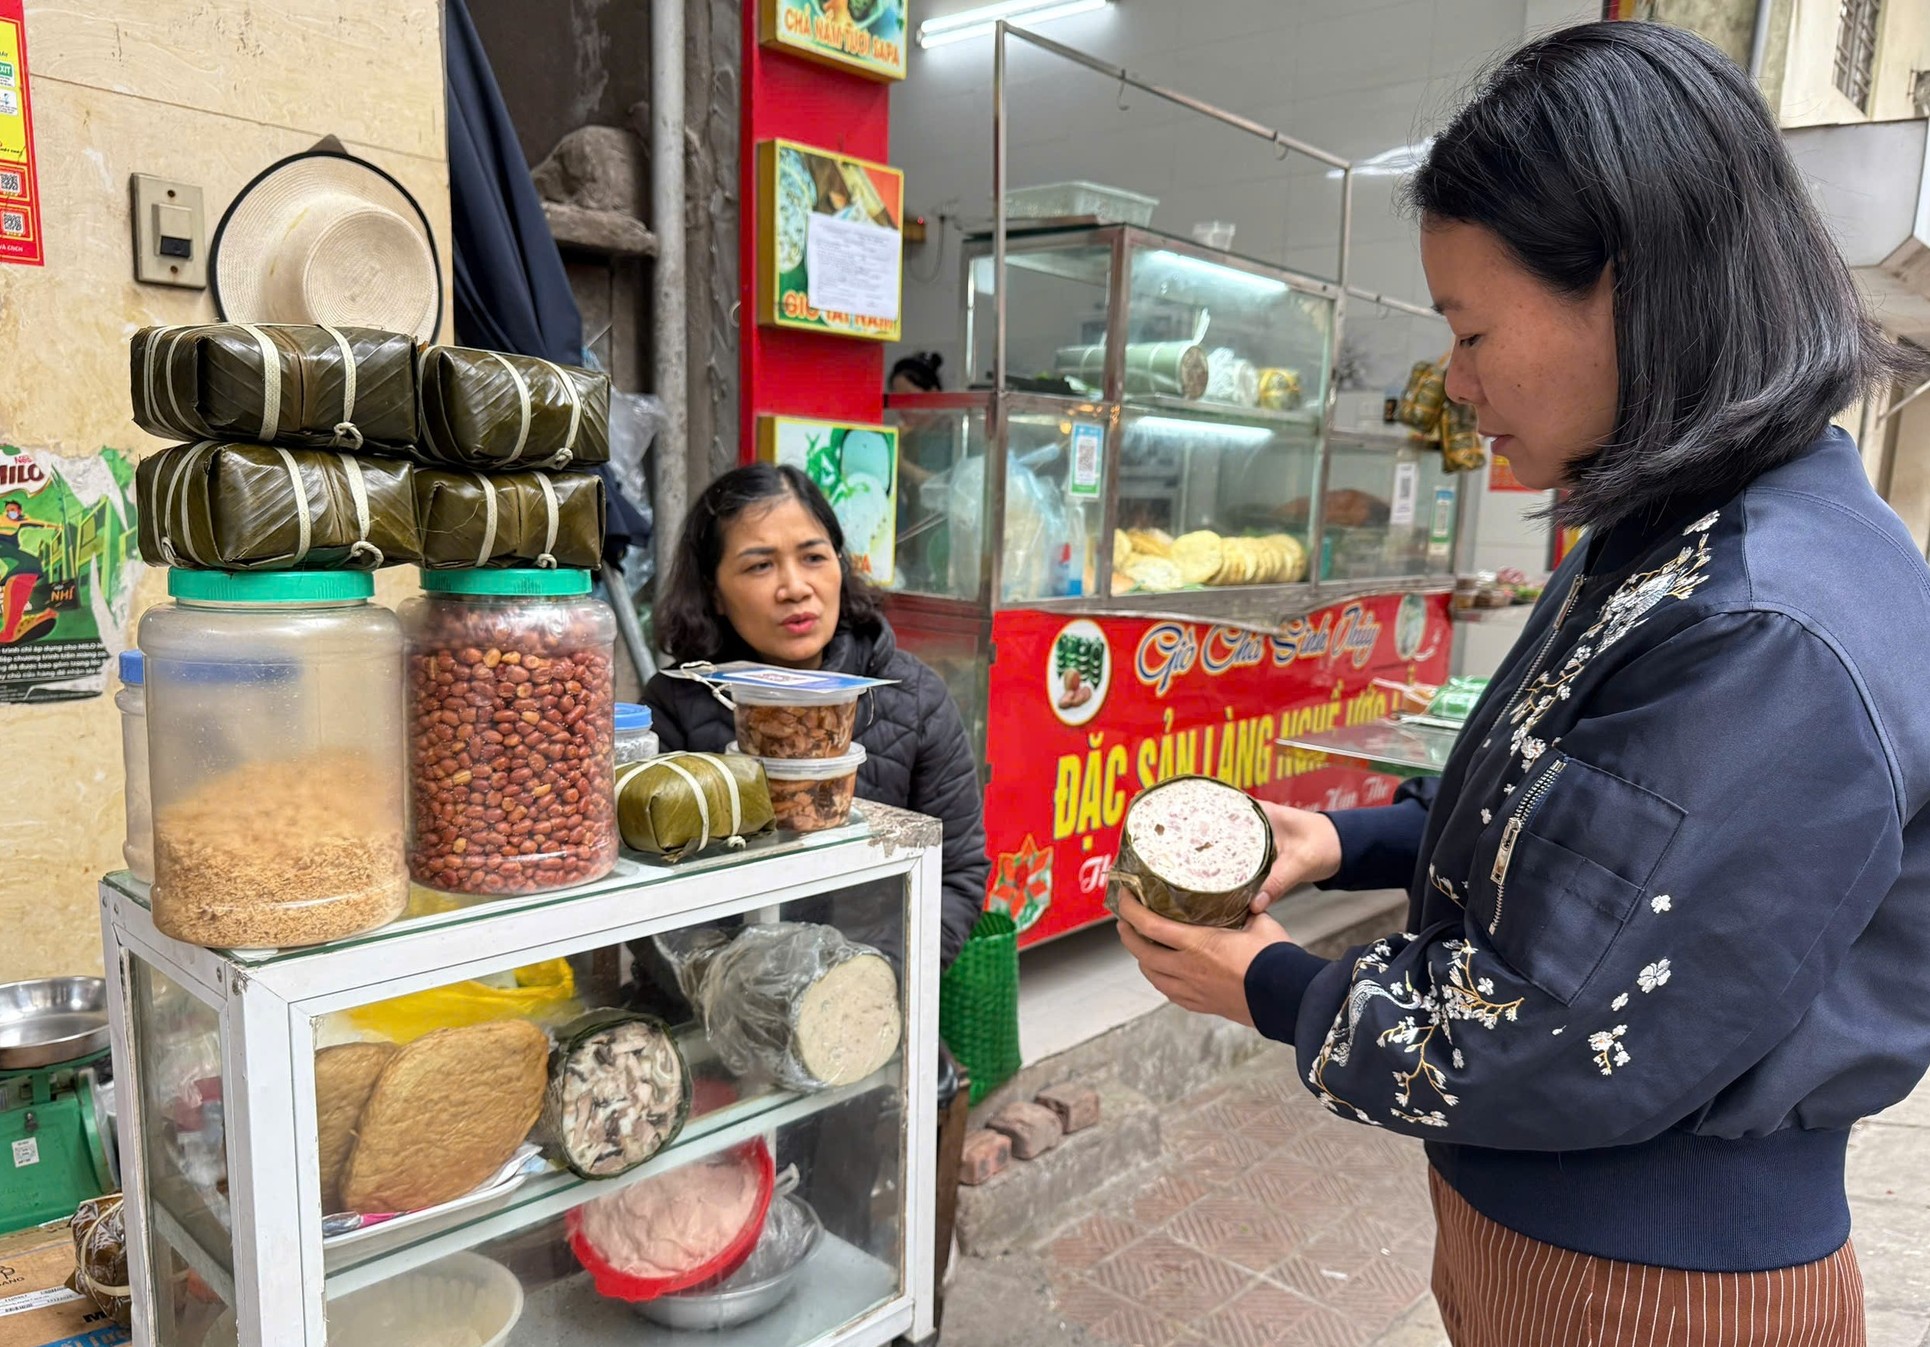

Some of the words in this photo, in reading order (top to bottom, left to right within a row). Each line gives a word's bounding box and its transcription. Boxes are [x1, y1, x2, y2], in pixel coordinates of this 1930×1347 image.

[872, 36, 900, 66] SAPA
[1134, 621, 1197, 696] Giò
[1054, 731, 1128, 851] ĐẶC
[1137, 707, 1197, 790] SẢN
[1203, 705, 1275, 788] LÀNG
